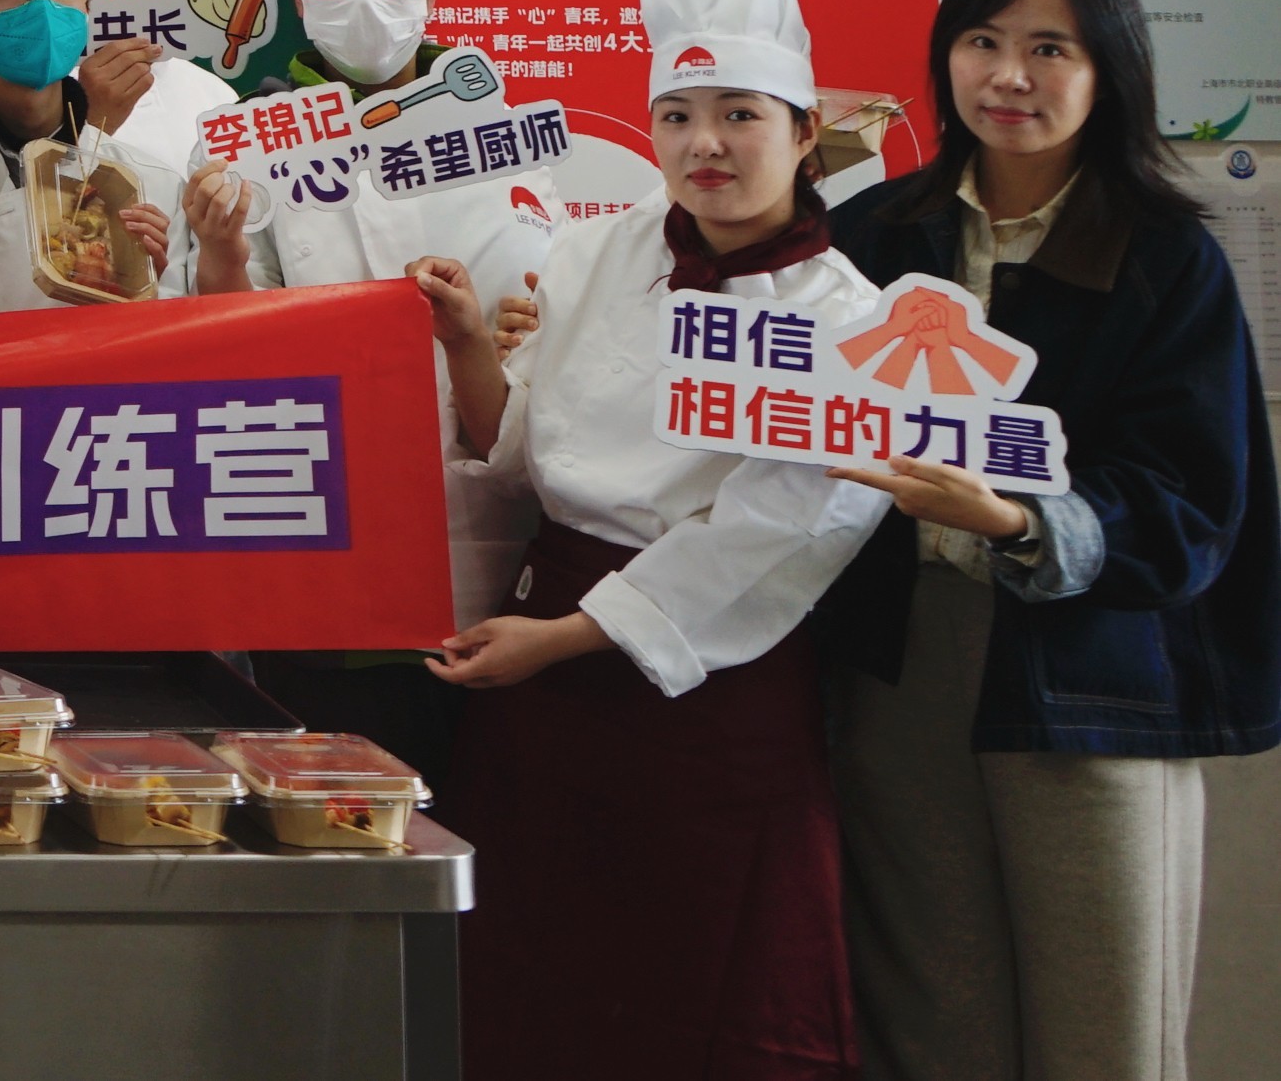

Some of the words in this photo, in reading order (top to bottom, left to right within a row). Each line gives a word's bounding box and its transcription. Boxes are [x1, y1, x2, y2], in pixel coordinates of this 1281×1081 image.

[202, 90, 352, 164] 李锦记
[669, 301, 816, 374] 相信
[667, 375, 1053, 483] 相信的力量
